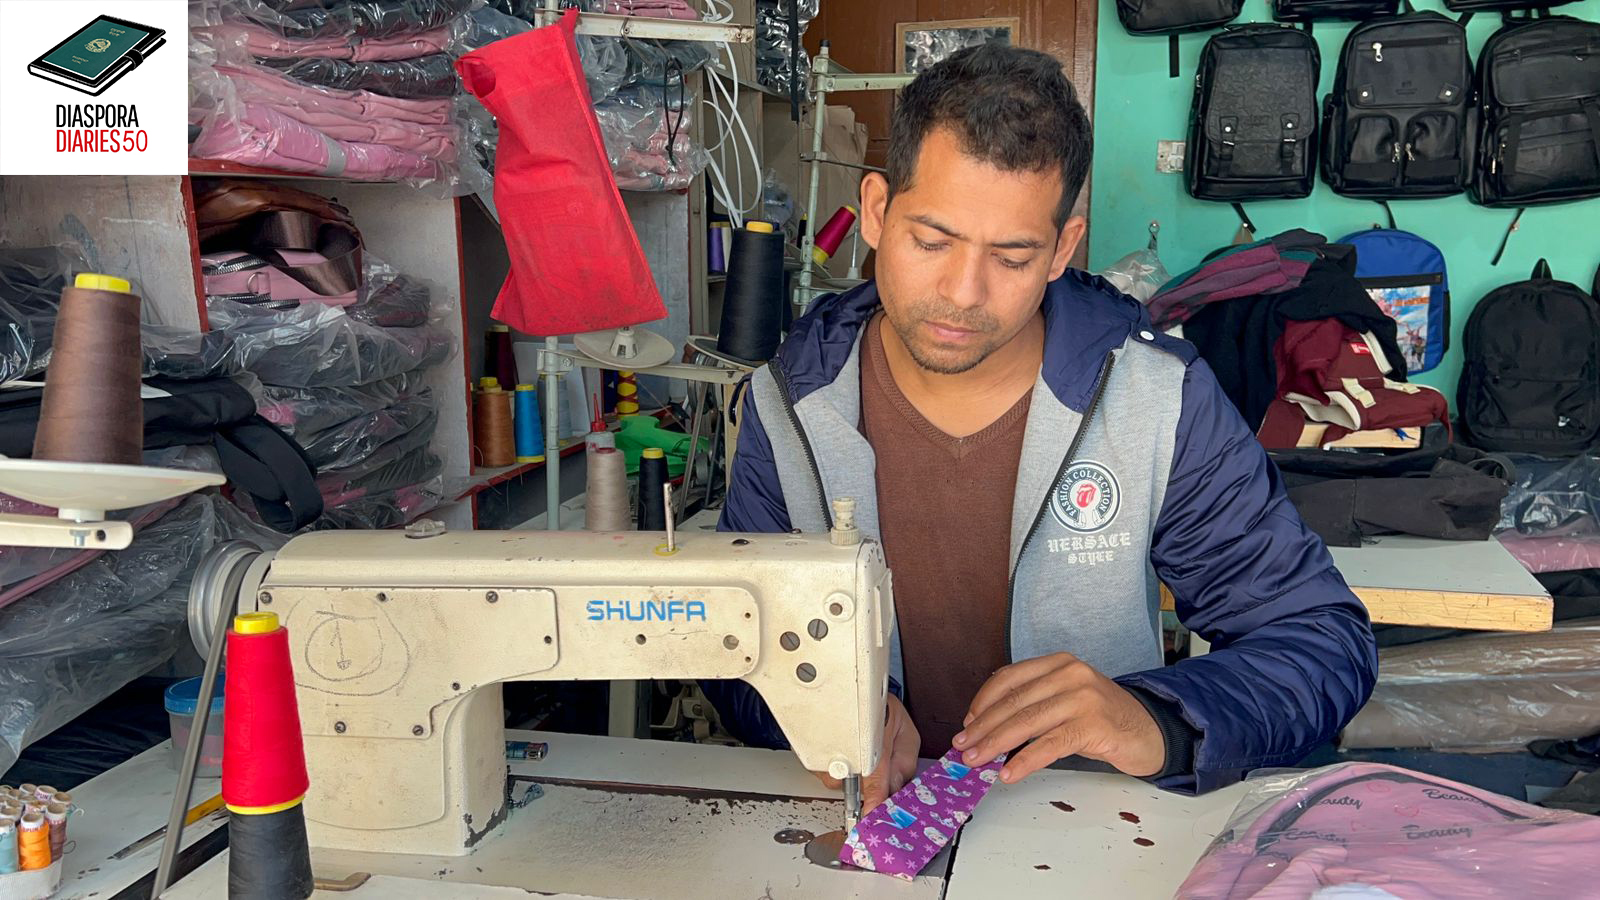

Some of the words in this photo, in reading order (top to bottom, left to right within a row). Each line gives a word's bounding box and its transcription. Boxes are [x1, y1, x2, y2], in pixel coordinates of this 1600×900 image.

[1059, 477, 1078, 517] FASHION
[1072, 469, 1111, 513] COLLECTION
[586, 600, 707, 622] SHUNFA
